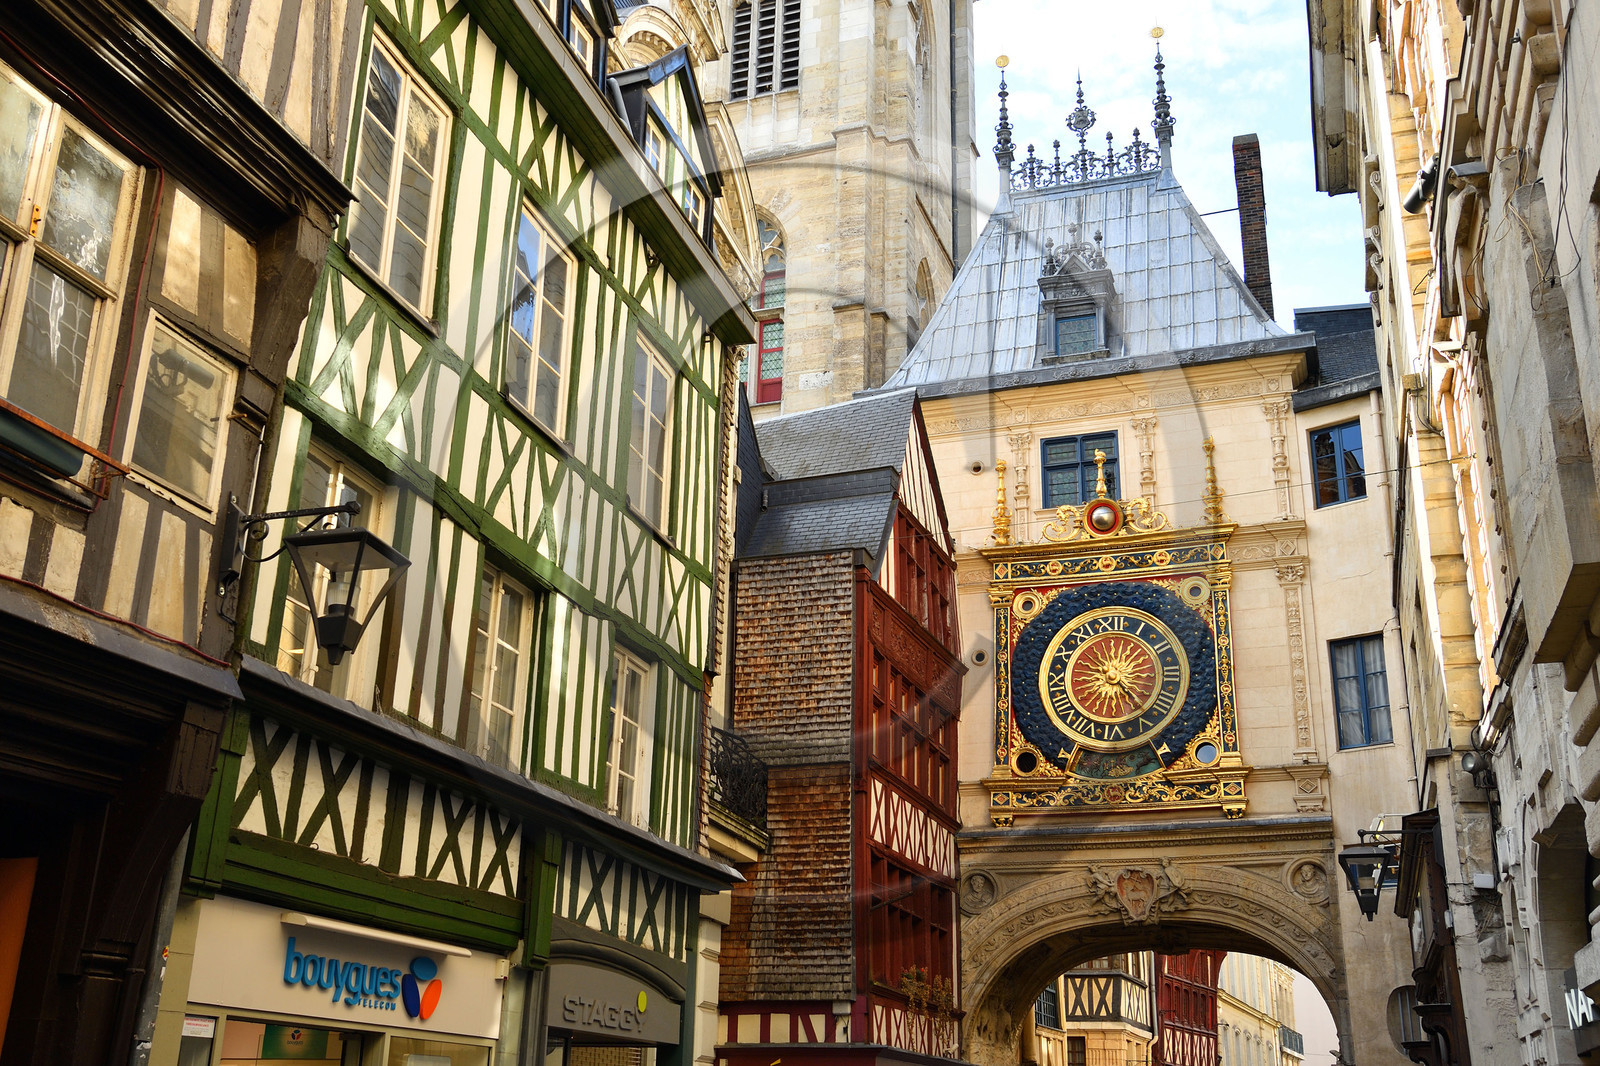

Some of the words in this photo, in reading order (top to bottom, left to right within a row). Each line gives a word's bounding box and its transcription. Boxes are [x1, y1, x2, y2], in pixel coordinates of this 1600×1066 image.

[1098, 616, 1124, 633] XII
[1135, 622, 1145, 635] I
[1072, 623, 1094, 644] XI
[1055, 645, 1073, 662] X
[1154, 640, 1171, 653] II
[1049, 671, 1065, 692] IX
[1164, 666, 1179, 681] III
[1052, 694, 1075, 724] VIII
[1153, 690, 1175, 714] IIII
[1072, 717, 1095, 738] VII
[1104, 725, 1125, 739] VI
[1139, 718, 1154, 732] V
[284, 936, 402, 1006] bouygues
[358, 997, 397, 1011] TELECOM
[563, 994, 648, 1034] STAGGY
